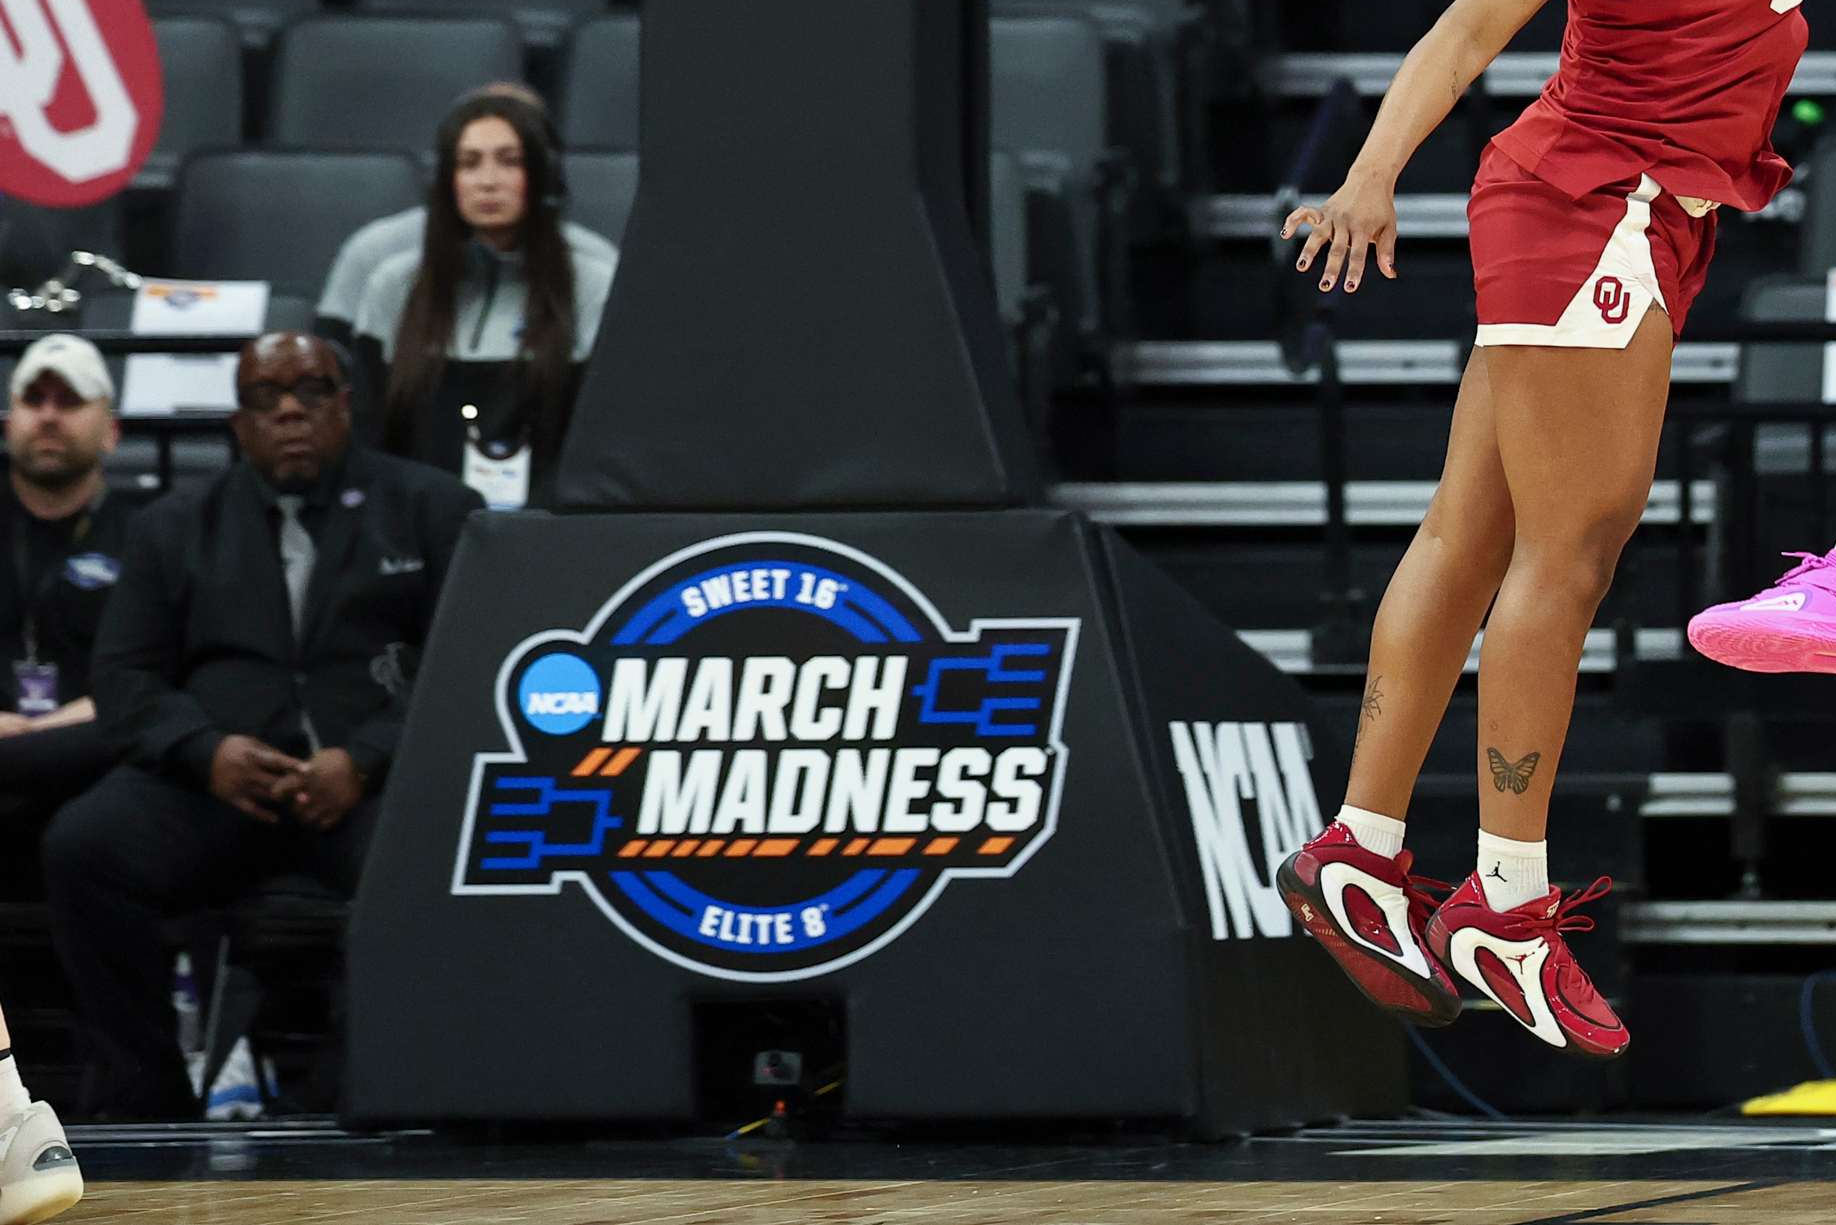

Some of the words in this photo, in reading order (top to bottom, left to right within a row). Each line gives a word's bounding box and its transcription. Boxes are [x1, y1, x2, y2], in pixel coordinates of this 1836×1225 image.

[1593, 276, 1631, 324] OU
[680, 568, 791, 618] SWEET
[794, 572, 839, 610] 16
[526, 692, 600, 715] NCAA
[601, 654, 909, 743] MARCH
[636, 746, 1048, 835] MADNESS
[698, 904, 795, 945] ELITE
[801, 905, 828, 938] 8
